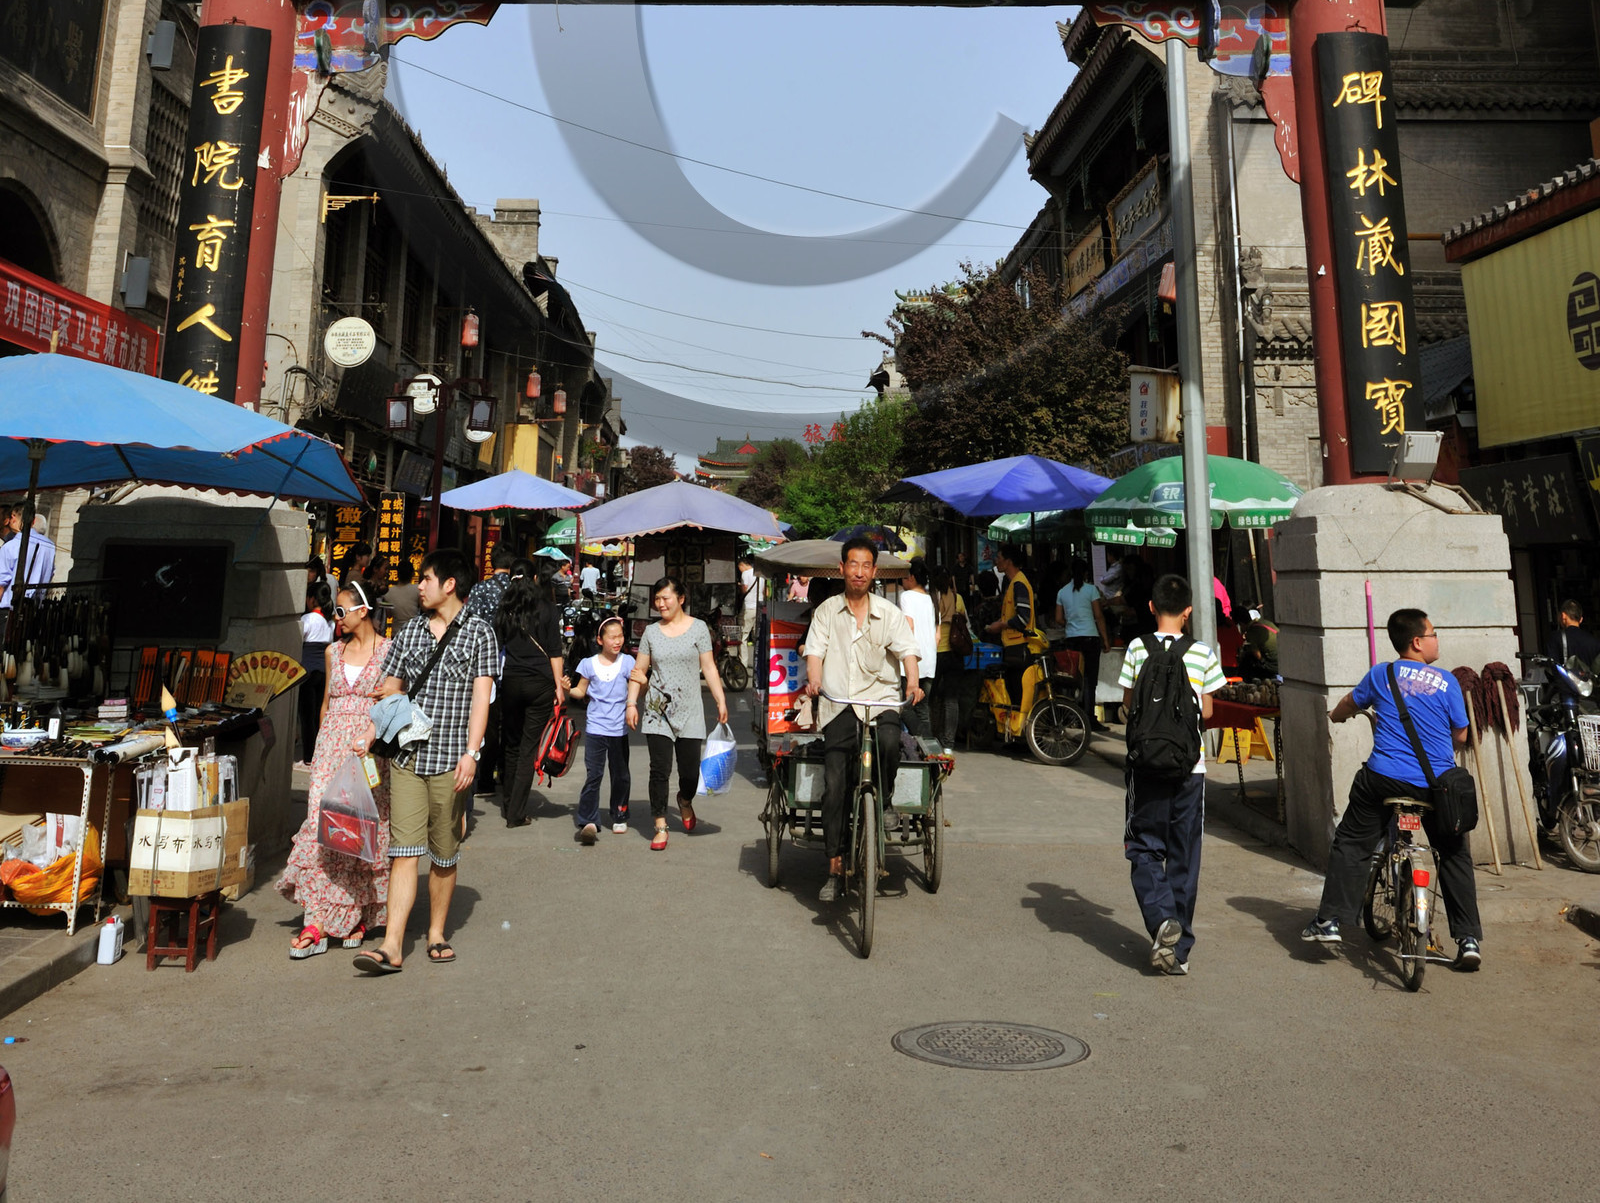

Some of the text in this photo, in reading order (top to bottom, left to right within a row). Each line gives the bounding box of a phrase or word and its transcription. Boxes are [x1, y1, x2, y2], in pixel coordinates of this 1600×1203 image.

[4, 280, 148, 375] 巩固国家卫生城市成果
[1399, 665, 1450, 694] WESTER
[138, 835, 186, 854] 水写布
